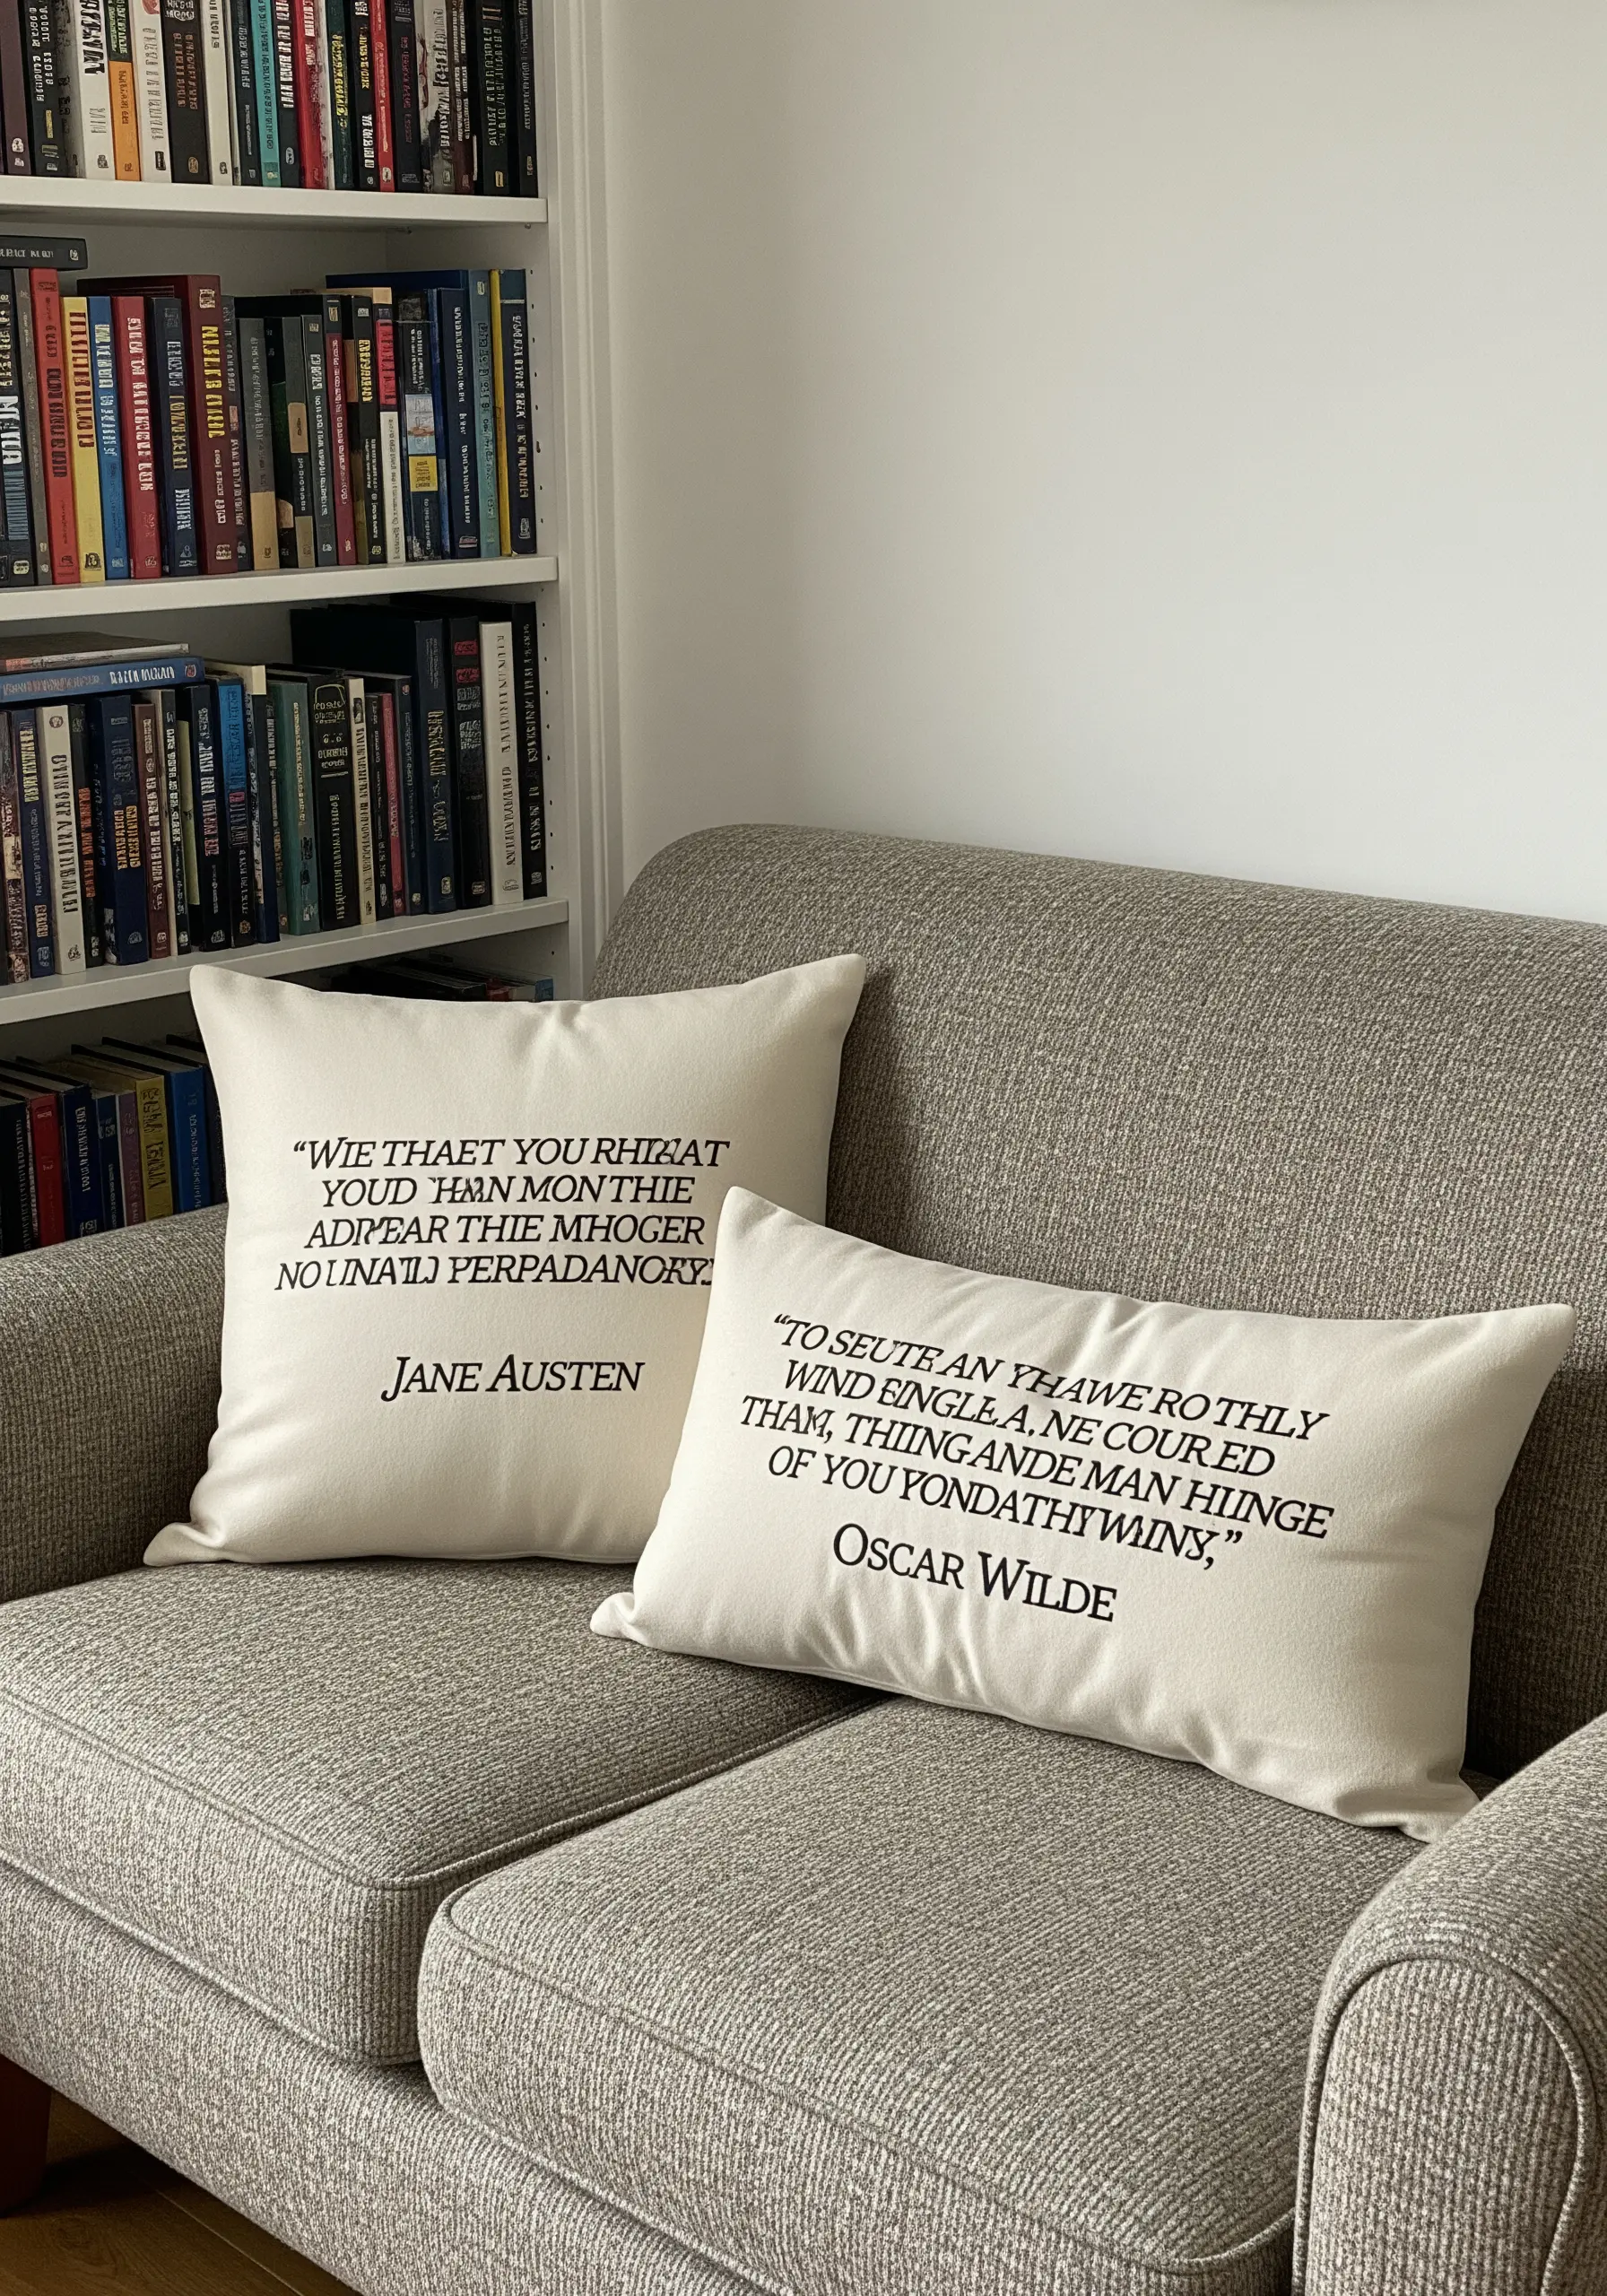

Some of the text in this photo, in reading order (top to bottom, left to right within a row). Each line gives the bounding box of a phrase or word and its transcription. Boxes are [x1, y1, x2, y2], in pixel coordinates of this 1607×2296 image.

[382, 1139, 506, 1166] THAET
[513, 1137, 589, 1165] YOU
[322, 1177, 417, 1207] YOUD
[456, 1214, 544, 1243] THIE
[549, 1214, 706, 1245] MHOGER
[768, 1445, 817, 1479] OF
[821, 1453, 899, 1495] YOU
